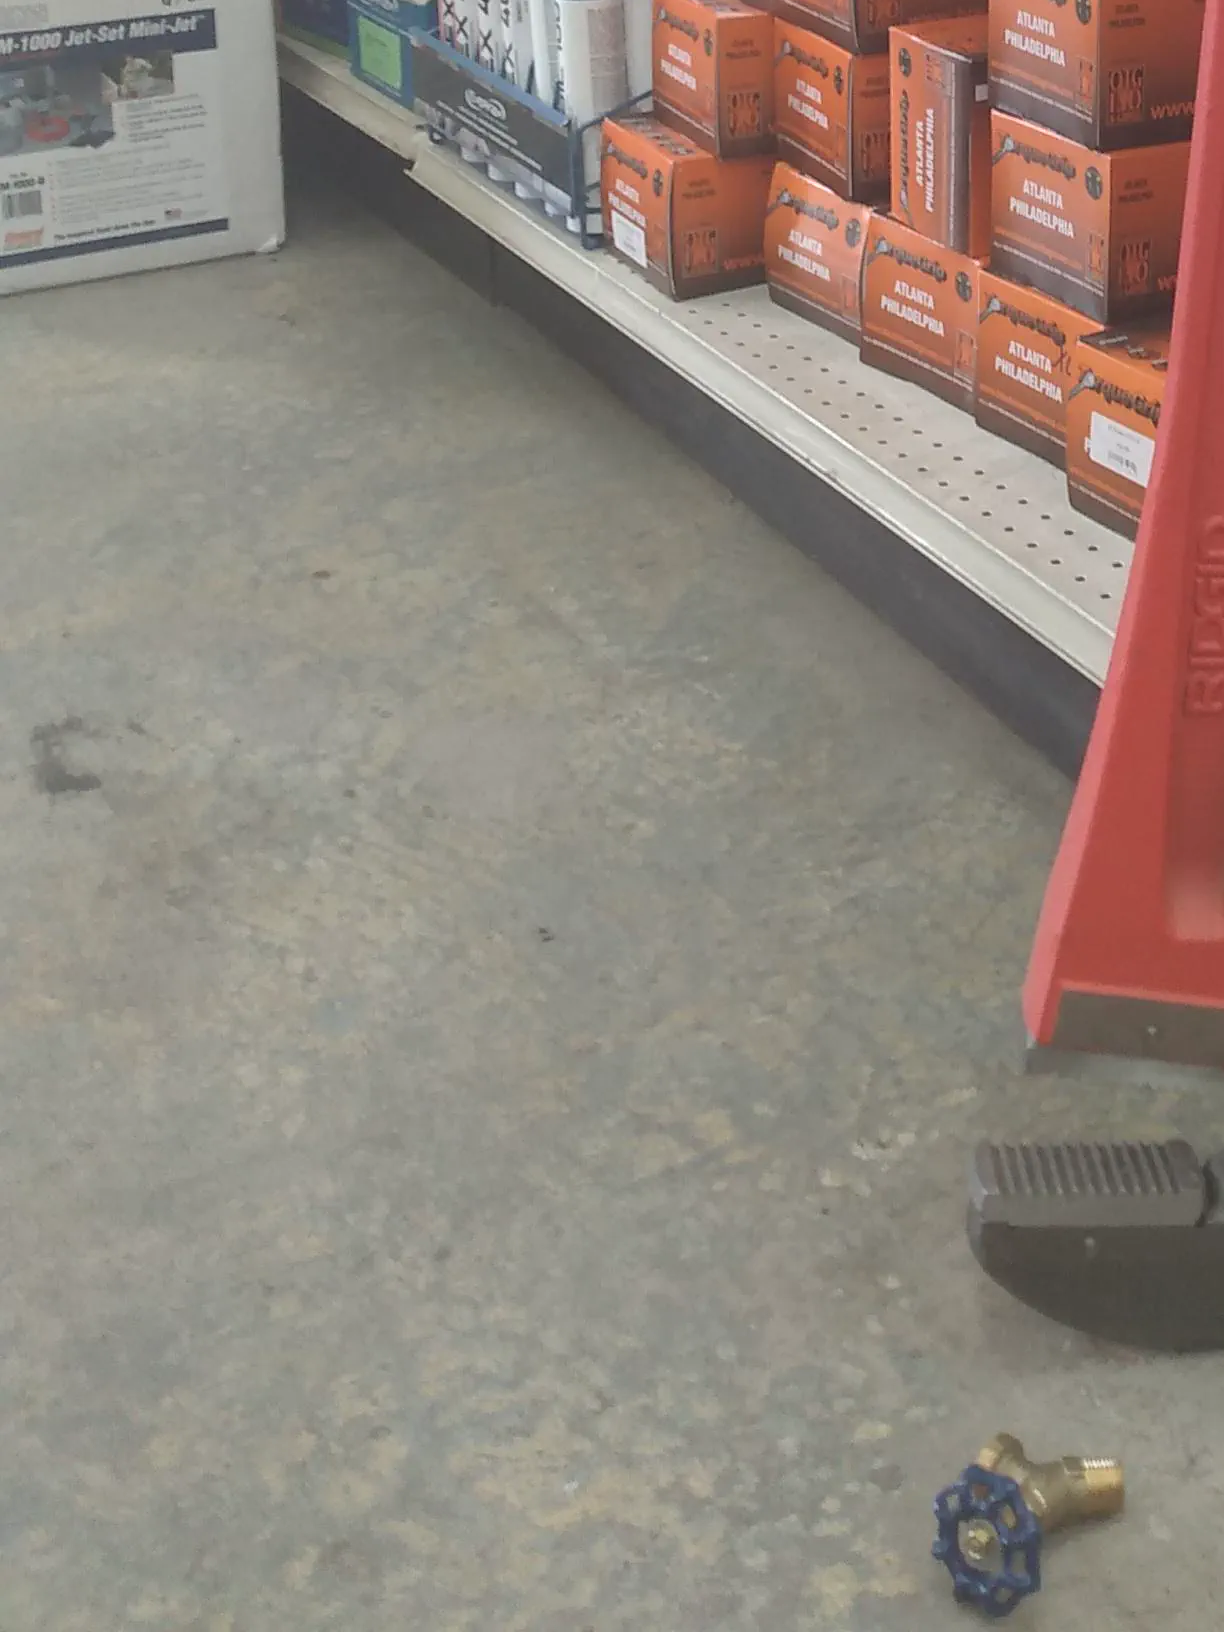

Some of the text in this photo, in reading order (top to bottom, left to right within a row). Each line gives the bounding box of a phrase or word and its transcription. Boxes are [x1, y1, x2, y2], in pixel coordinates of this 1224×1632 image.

[1017, 9, 1055, 38] ATLANTA
[1004, 29, 1066, 67] PHILADELPHIA
[916, 120, 924, 187] ATLANTA
[925, 108, 934, 213] PHILADELPHIA
[1023, 178, 1064, 210] ATLANTA
[1009, 196, 1075, 239] PHILADELPHIA
[788, 229, 823, 256] ATLANTA
[894, 280, 935, 311] ATLANTA
[880, 294, 945, 337] PHILADELPHIA
[1008, 340, 1052, 373] ATLANTA
[995, 356, 1063, 404] PHILADELPHIA
